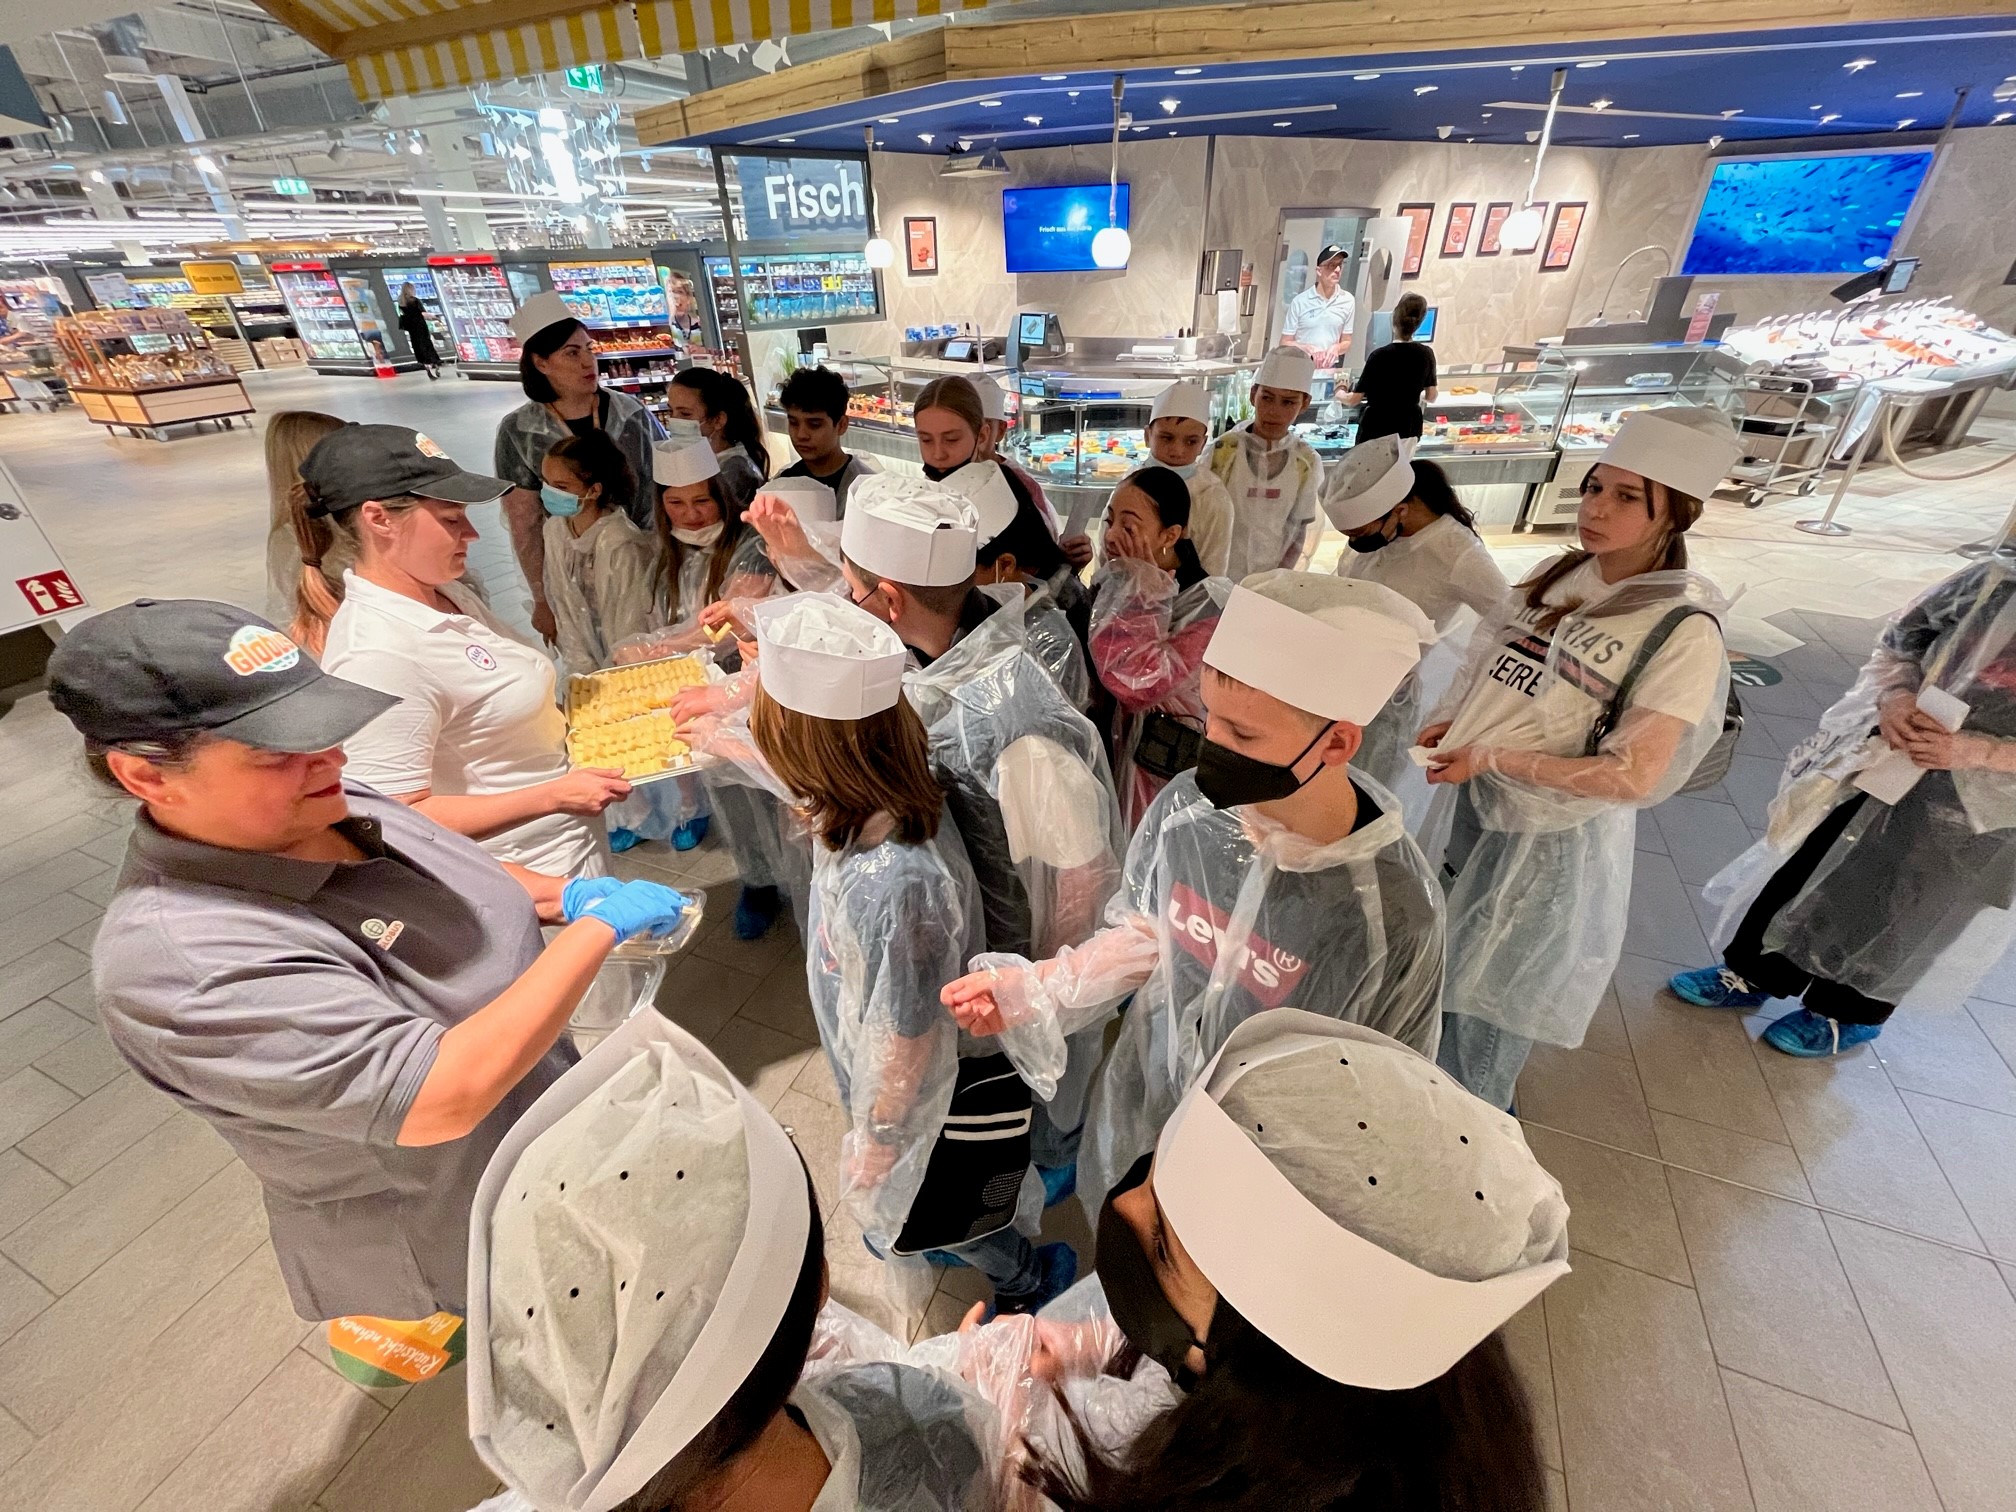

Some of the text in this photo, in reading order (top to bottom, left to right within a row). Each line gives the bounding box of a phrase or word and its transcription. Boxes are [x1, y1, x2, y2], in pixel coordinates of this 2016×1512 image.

[764, 168, 865, 220] Fisch
[1039, 225, 1056, 233] Frisch
[339, 1317, 441, 1375] Rücksicht nehmen
